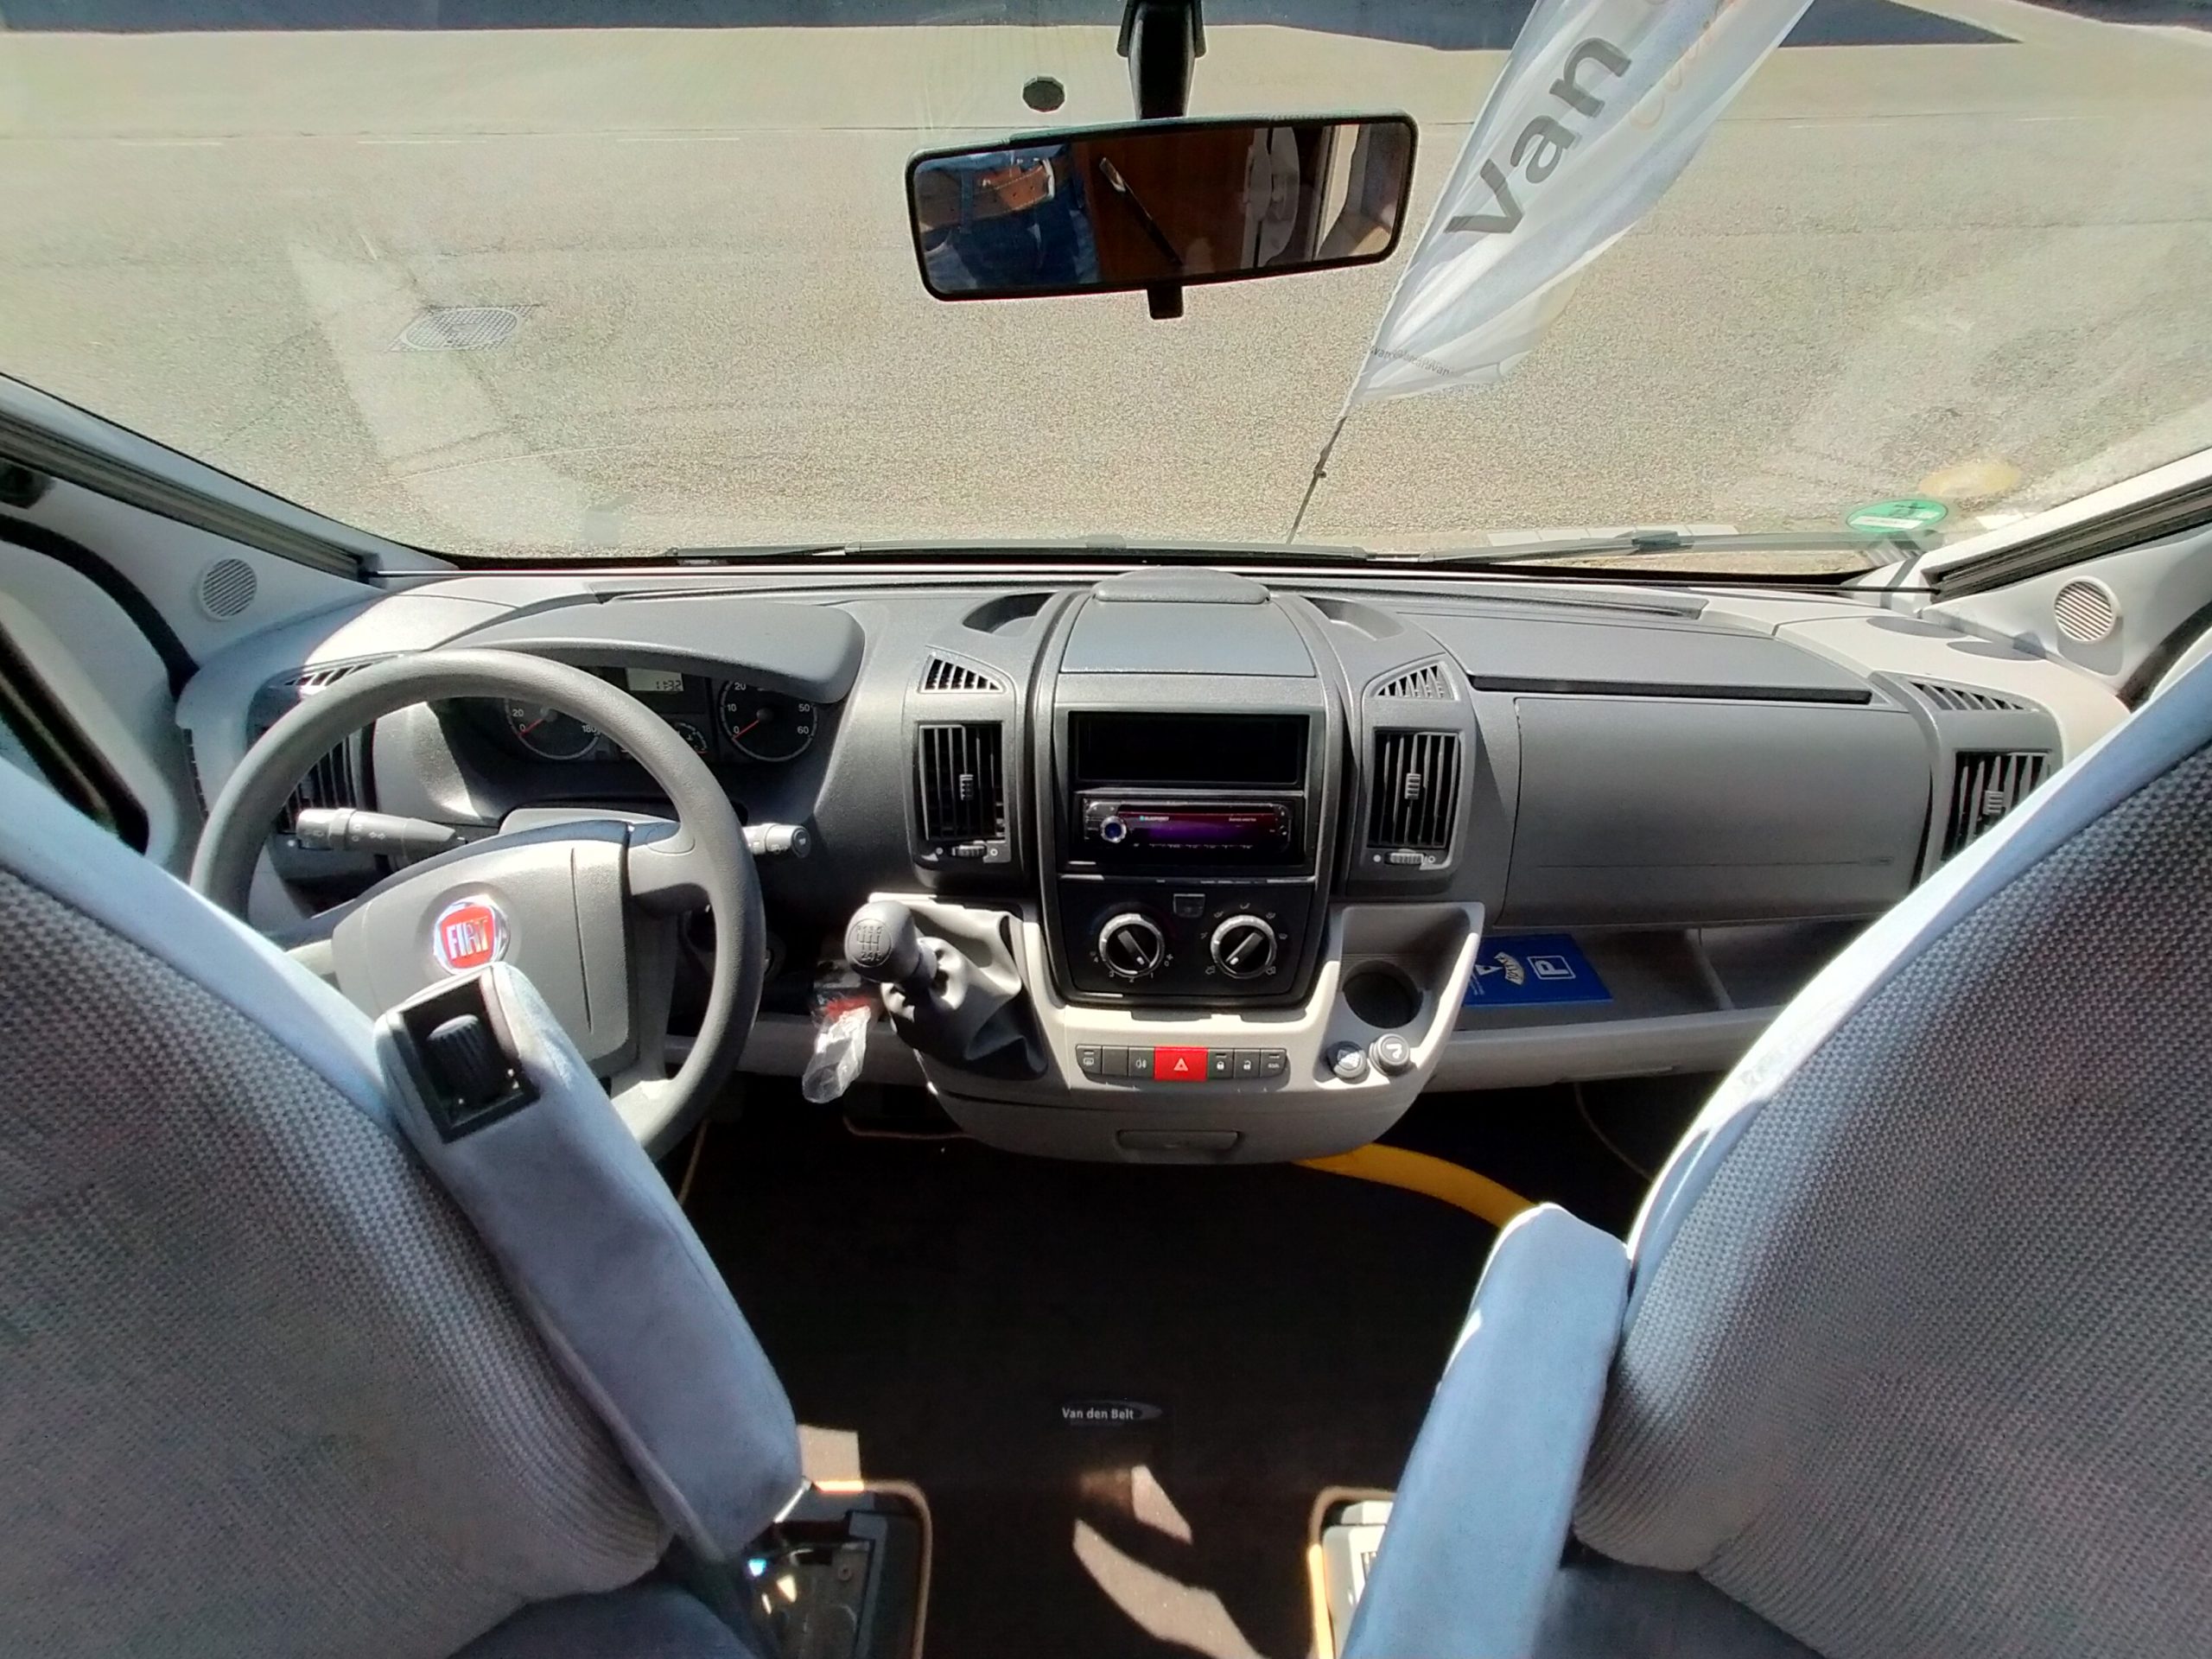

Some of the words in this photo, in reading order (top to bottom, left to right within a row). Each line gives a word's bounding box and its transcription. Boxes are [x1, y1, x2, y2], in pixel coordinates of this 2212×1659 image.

[1444, 37, 1631, 234] Van
[512, 709, 524, 717] 20
[727, 703, 737, 712] 10
[798, 703, 810, 712] 50
[797, 726, 810, 734] 60
[446, 916, 489, 960] FIAT
[1535, 960, 1569, 976] P
[1062, 1407, 1084, 1419] Van
[1086, 1407, 1109, 1421] den
[1111, 1408, 1135, 1421] Belt
